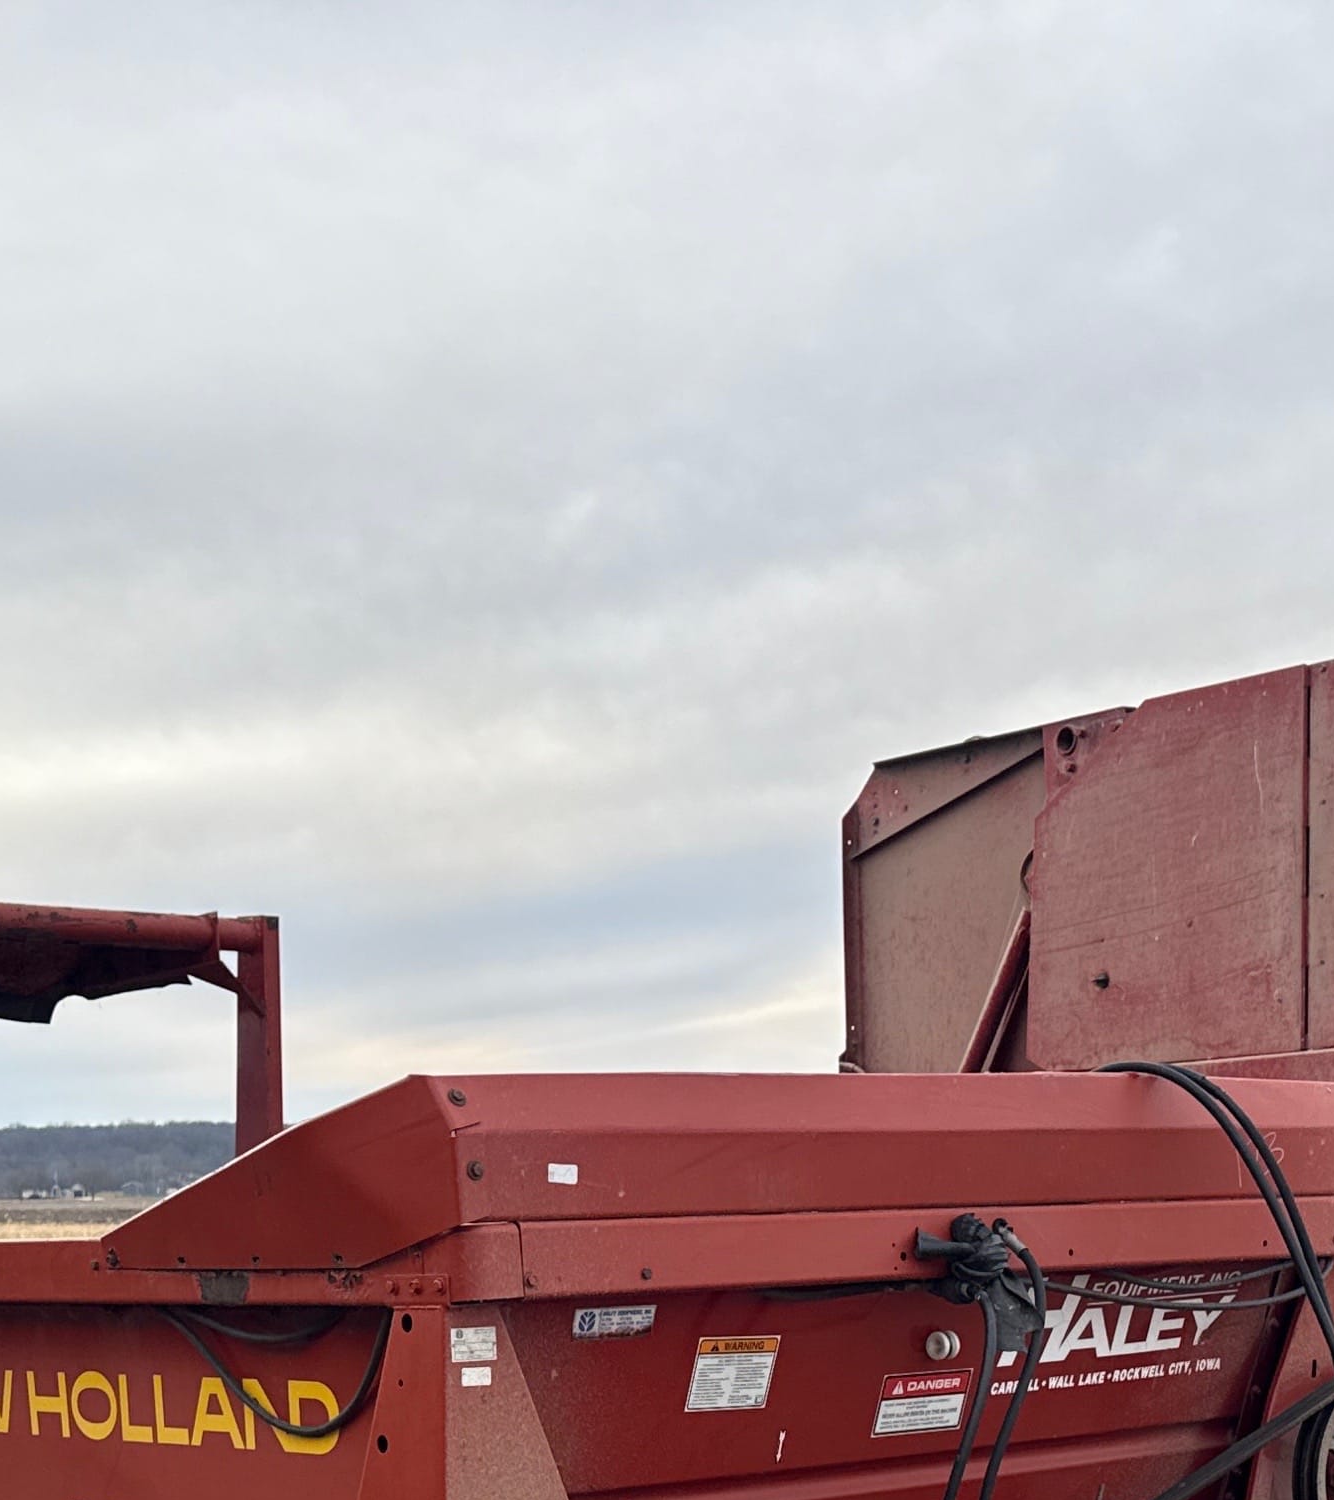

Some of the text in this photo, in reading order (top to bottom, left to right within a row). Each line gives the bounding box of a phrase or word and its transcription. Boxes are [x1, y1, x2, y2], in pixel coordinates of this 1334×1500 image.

[723, 1340, 765, 1351] WARNING
[906, 1377, 961, 1392] DANGER
[990, 1357, 1221, 1396] CARLL WALL LAKE ROCKWELL CITY, IOWA
[26, 1369, 341, 1456] HOLLAND
